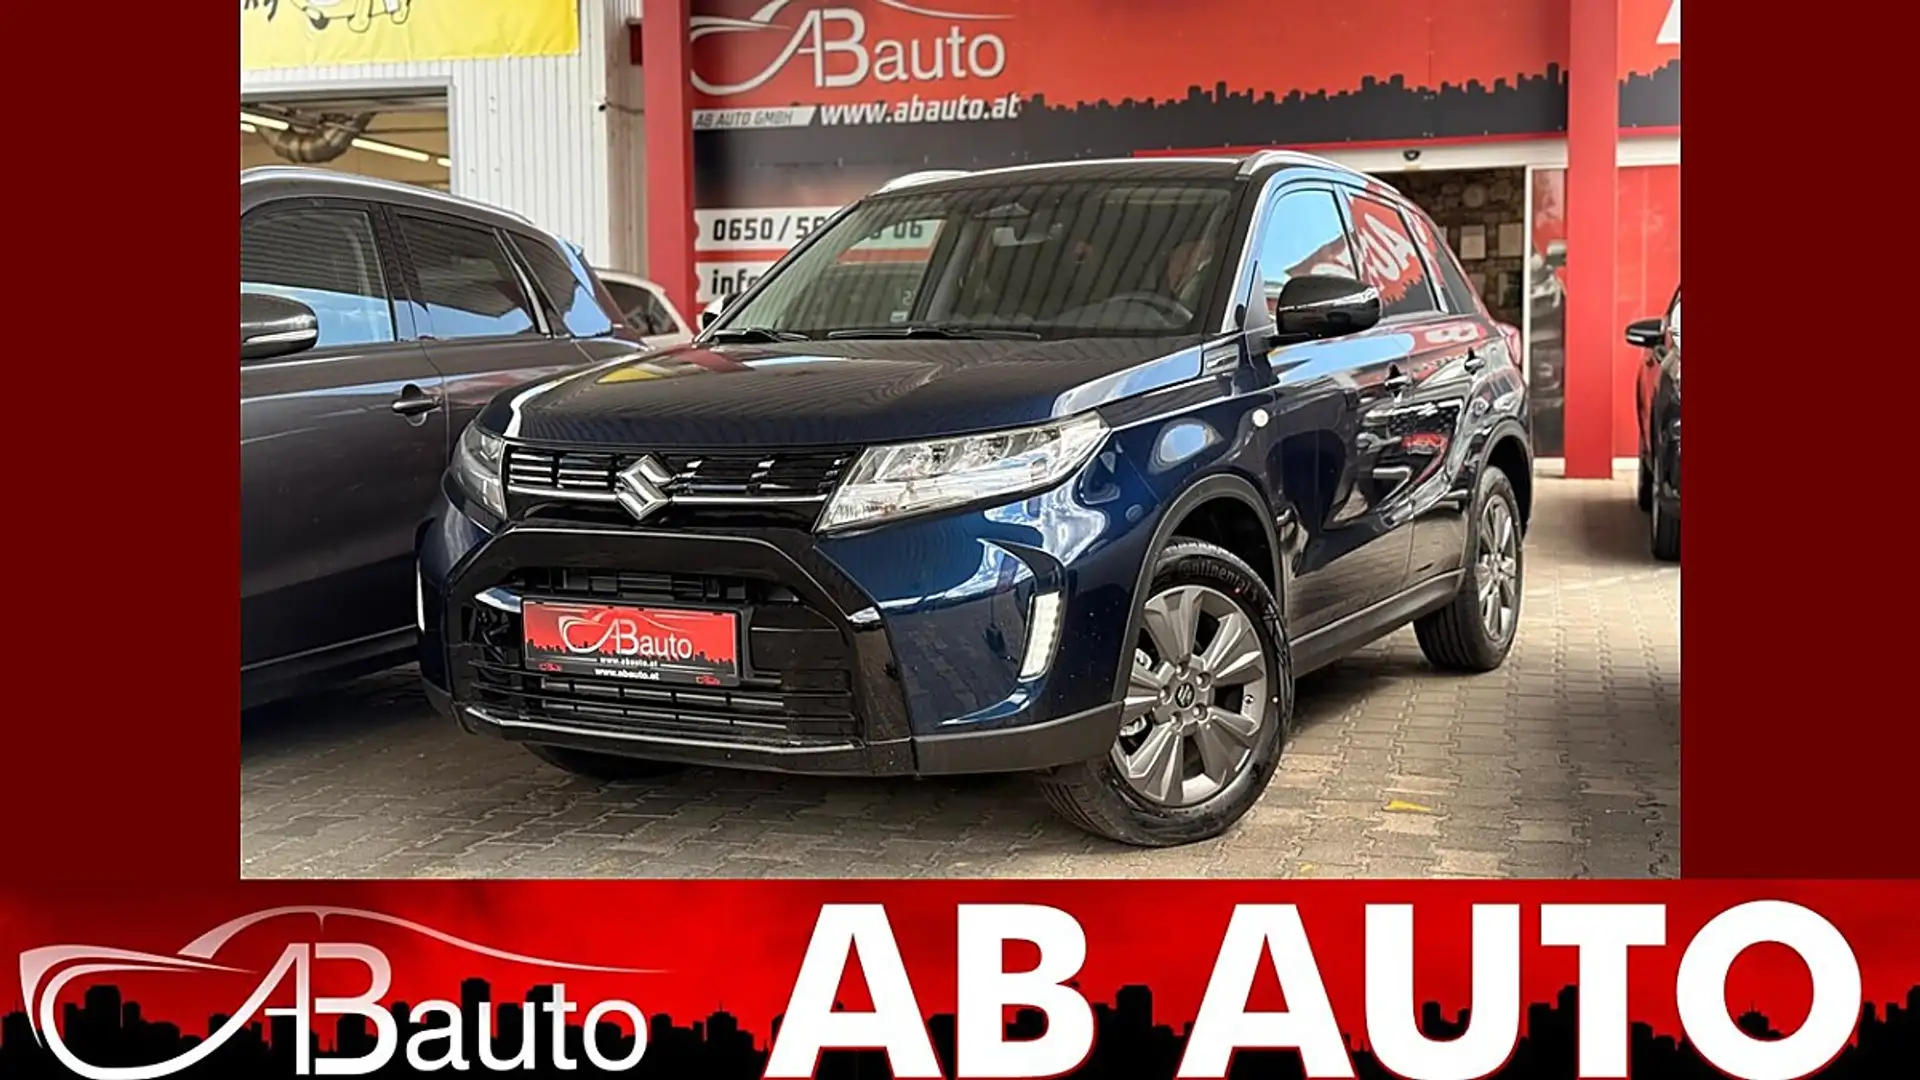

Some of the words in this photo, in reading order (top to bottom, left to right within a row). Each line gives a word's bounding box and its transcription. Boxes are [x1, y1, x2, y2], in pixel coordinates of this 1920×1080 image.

[716, 111, 752, 126] AUTO
[820, 91, 1021, 126] www.abauto.at
[713, 217, 773, 241] 0650
